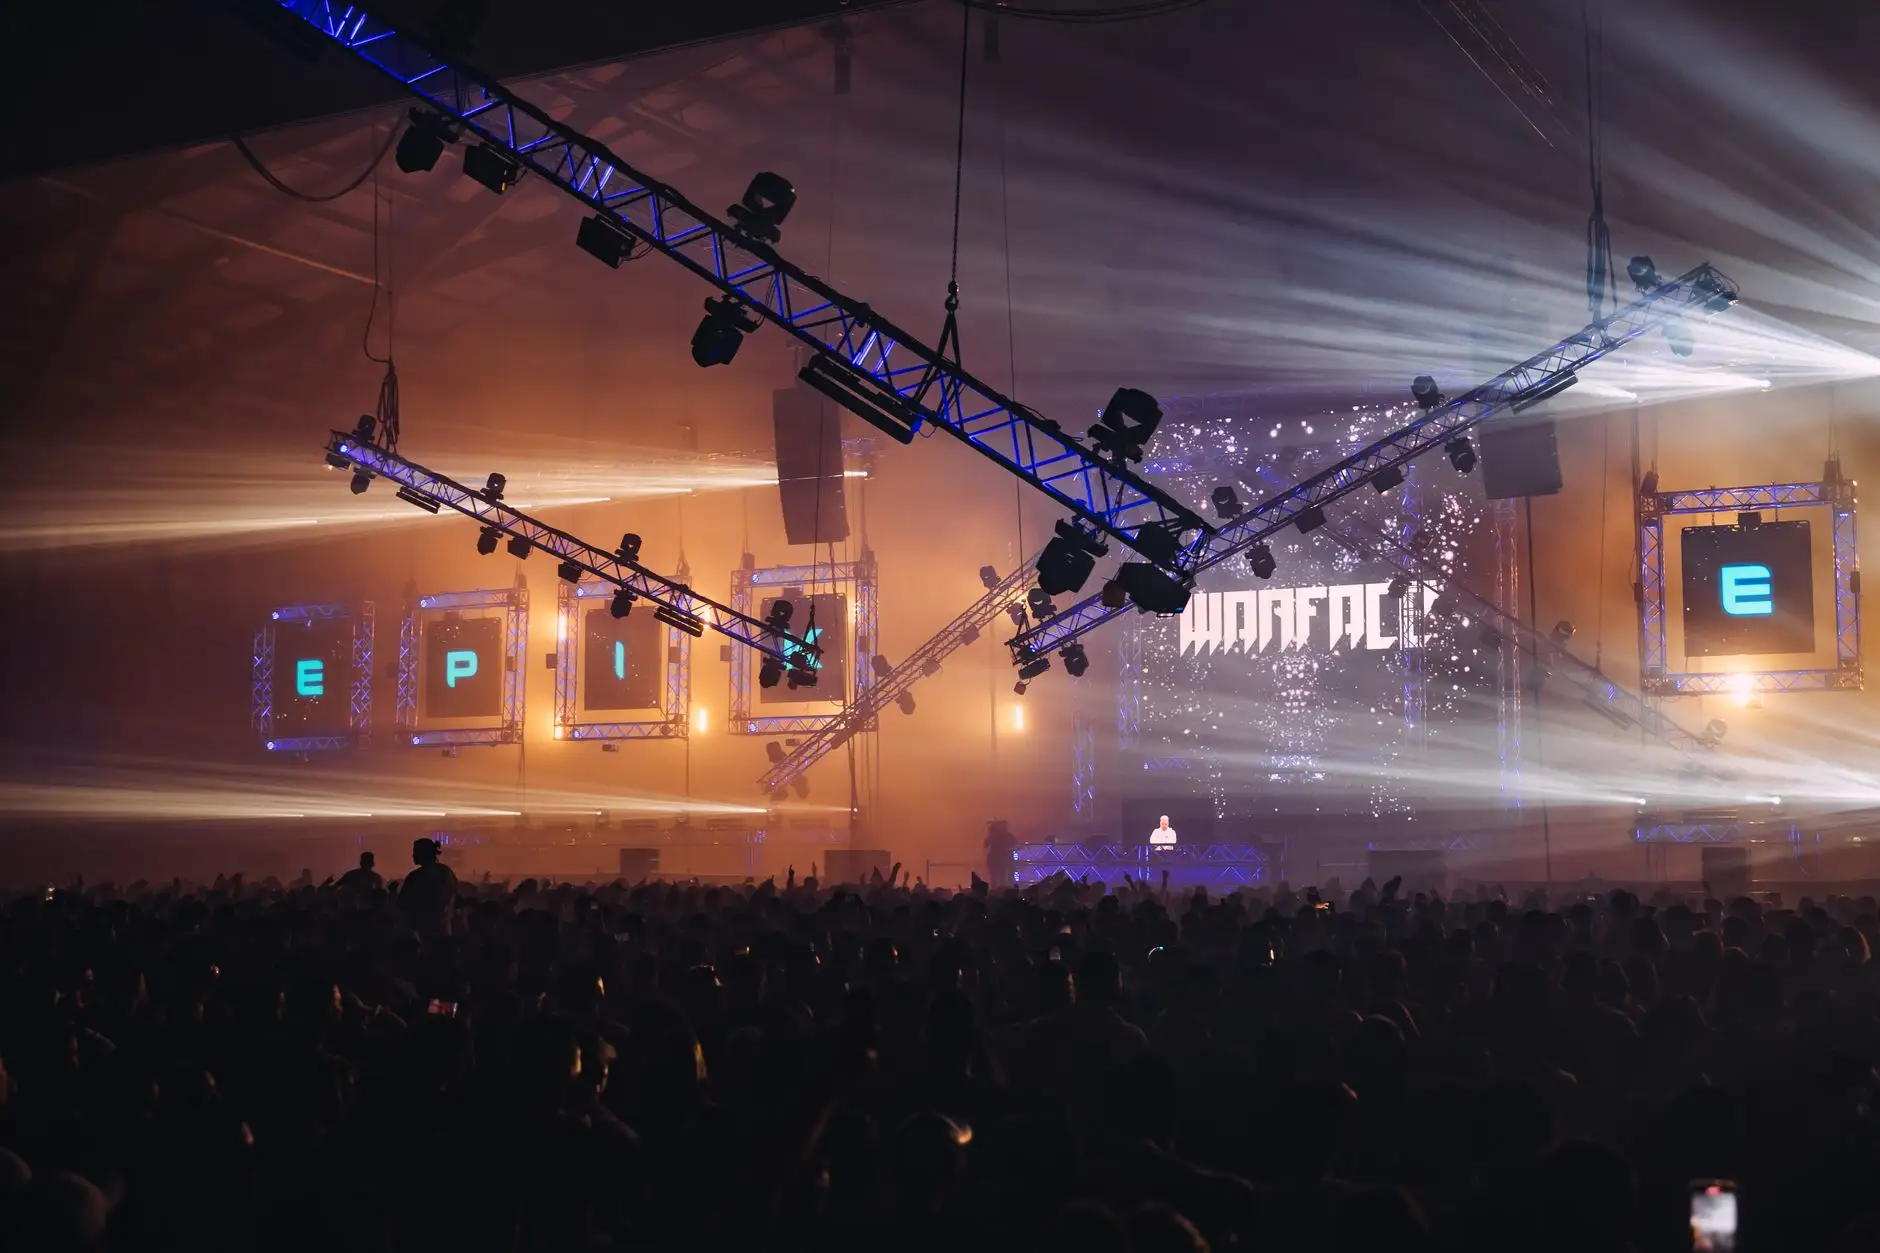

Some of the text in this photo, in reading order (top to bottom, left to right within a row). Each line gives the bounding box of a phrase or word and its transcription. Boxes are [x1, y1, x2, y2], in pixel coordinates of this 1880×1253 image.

[1720, 563, 1774, 616] E
[295, 658, 325, 697] E
[445, 650, 479, 689] P
[614, 641, 626, 678] I
